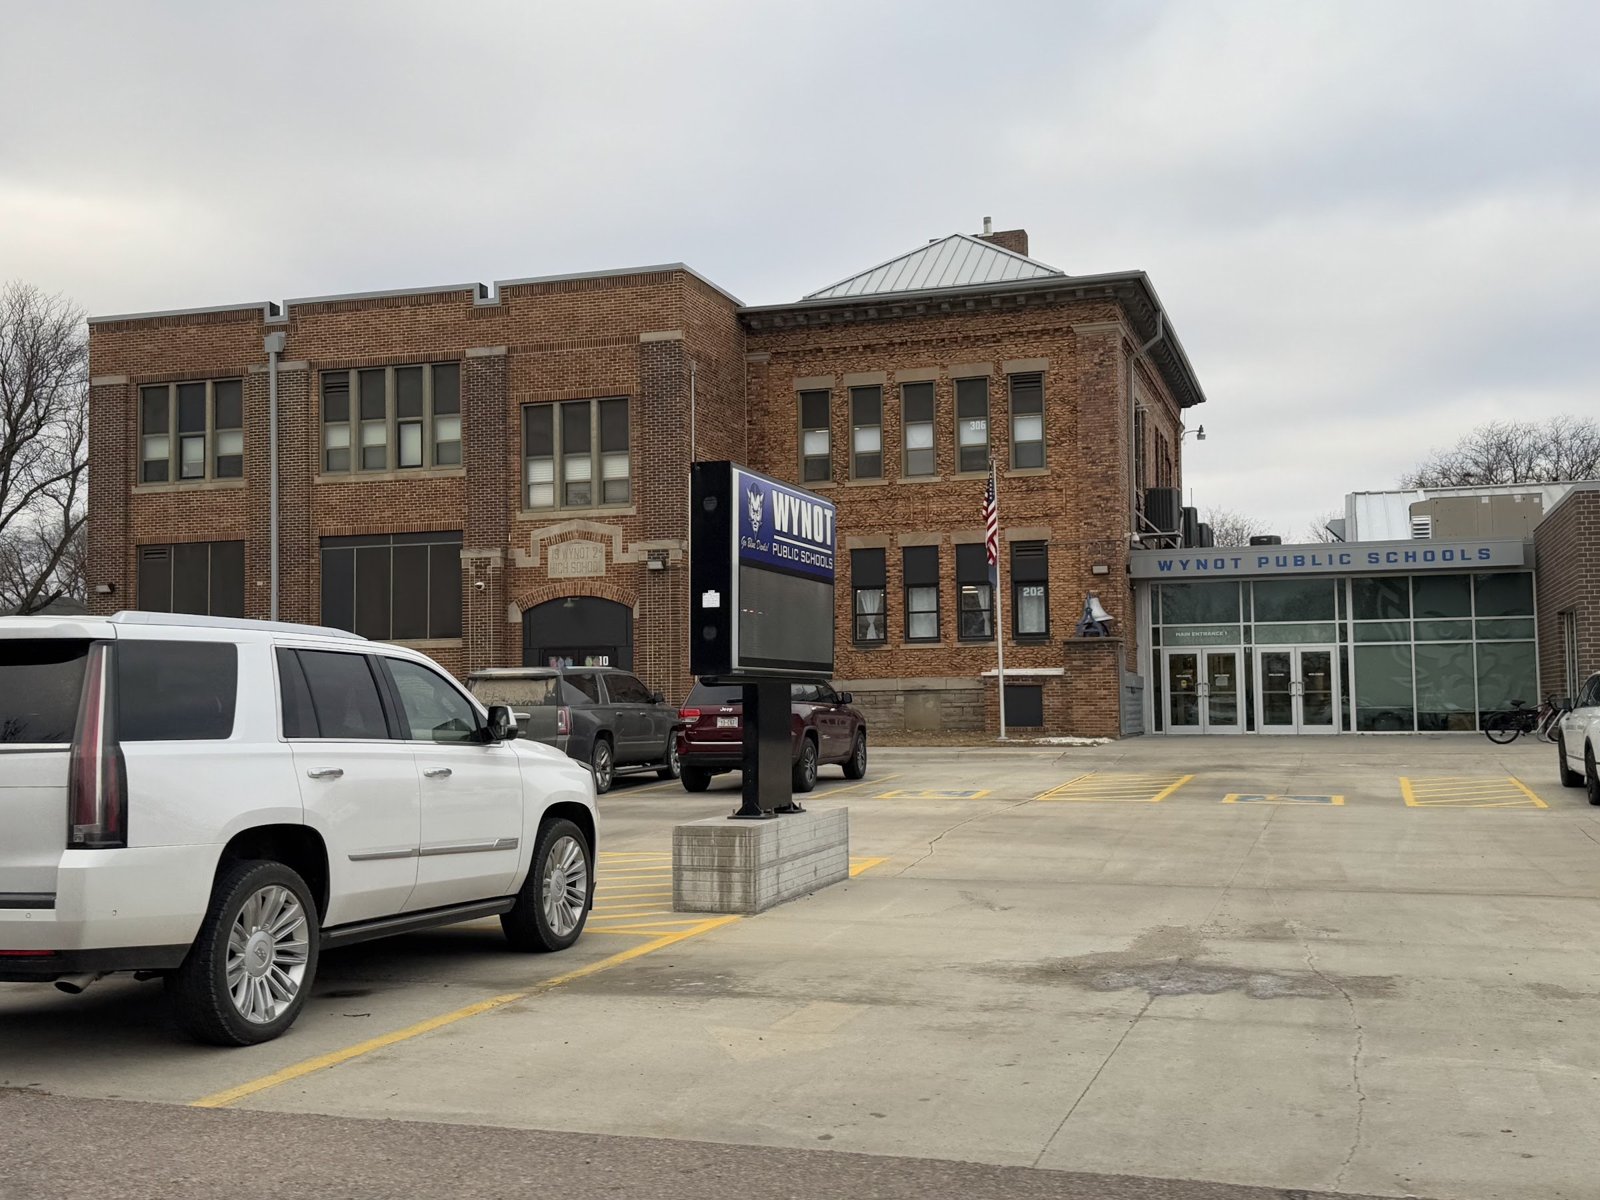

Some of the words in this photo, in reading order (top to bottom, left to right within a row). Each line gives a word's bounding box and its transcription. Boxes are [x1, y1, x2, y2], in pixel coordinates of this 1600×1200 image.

[969, 420, 986, 431] 306
[772, 490, 832, 545] WYNOT
[561, 546, 589, 560] WYNOT
[772, 543, 799, 560] PUBLIC
[801, 551, 832, 569] SCHOOLS
[1157, 557, 1242, 572] WYNOT
[1257, 553, 1351, 569] PUBLIC
[1367, 548, 1491, 564] SCHOOLS
[570, 560, 604, 574] SCHOOL
[1022, 587, 1044, 597] 202
[598, 655, 609, 666] 10
